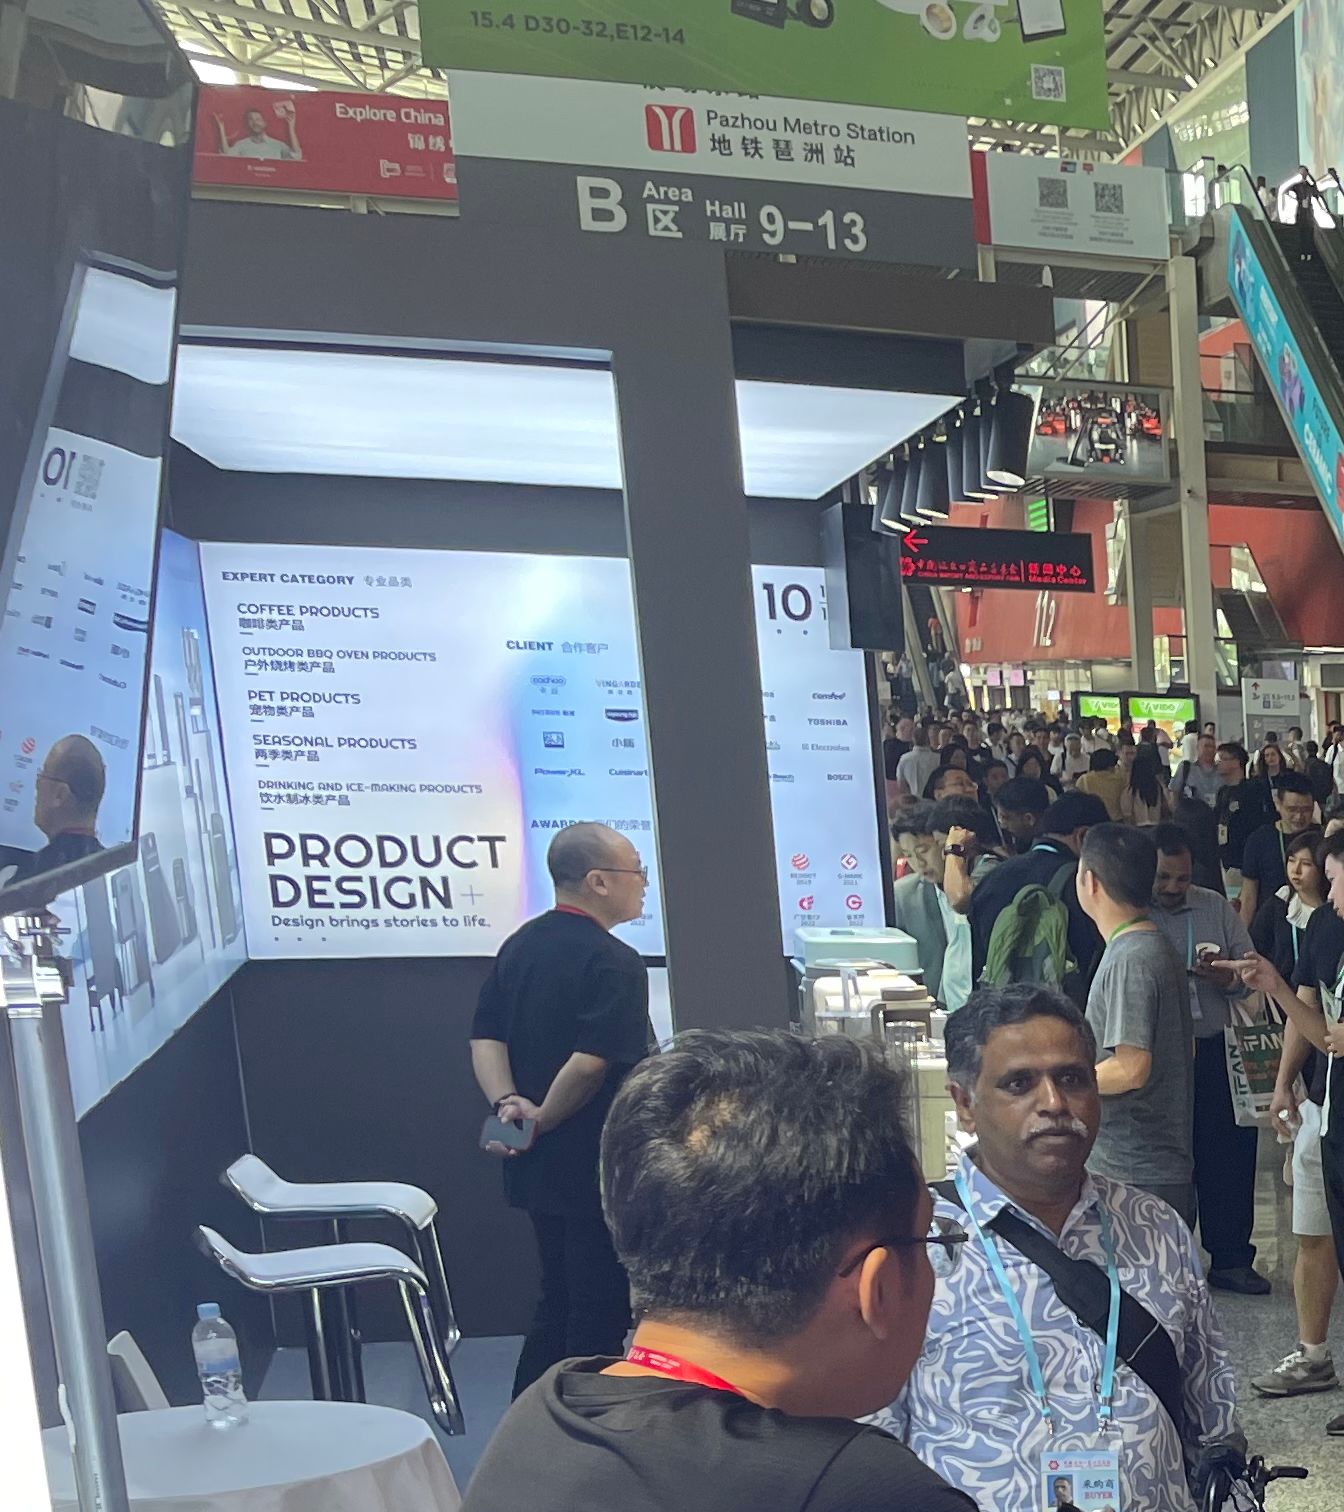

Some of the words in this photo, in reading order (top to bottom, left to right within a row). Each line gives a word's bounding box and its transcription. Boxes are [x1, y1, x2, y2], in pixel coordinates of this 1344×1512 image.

[470, 10, 516, 30] 15.4
[524, 14, 686, 46] D30-32,E12-14
[335, 102, 397, 123] Explore
[400, 107, 445, 126] China
[706, 109, 778, 132] Pazhou
[783, 116, 842, 138] Metro
[846, 122, 916, 146] Station
[709, 132, 857, 168] 地铁琶洲站
[641, 180, 694, 203] Area
[576, 175, 628, 233] B
[705, 199, 747, 220] Hall
[646, 203, 684, 239] 区
[708, 221, 748, 243] 展厅
[759, 203, 868, 253] 9-13
[221, 571, 275, 583] EXPERT
[280, 572, 355, 586] CATEGORY
[236, 602, 295, 616] COFFEE
[299, 604, 380, 619] PRODUCTS
[761, 582, 813, 622] 10
[242, 646, 304, 658] OUTDOOR
[307, 648, 333, 659] BBQ
[336, 649, 369, 660] OVEN
[372, 651, 437, 662] PRODUCTS
[506, 639, 554, 651] CLIENT
[247, 689, 275, 702] PET
[280, 691, 361, 705] PRODUCTS
[252, 734, 334, 748] SEASONAL
[337, 736, 417, 750] PRODUCTS
[258, 779, 315, 791] DRINKING
[317, 781, 343, 792] AND
[345, 782, 417, 793] ICE-MAKING
[419, 783, 483, 794] PRODUCTS
[263, 830, 506, 868] PRODUCT
[269, 874, 454, 910] DESIGN
[271, 914, 324, 930] Design
[328, 914, 379, 931] brings
[384, 916, 437, 928] stories
[442, 916, 459, 928] to
[463, 915, 491, 928] life.
[1084, 1491, 1113, 1500] BUYER
